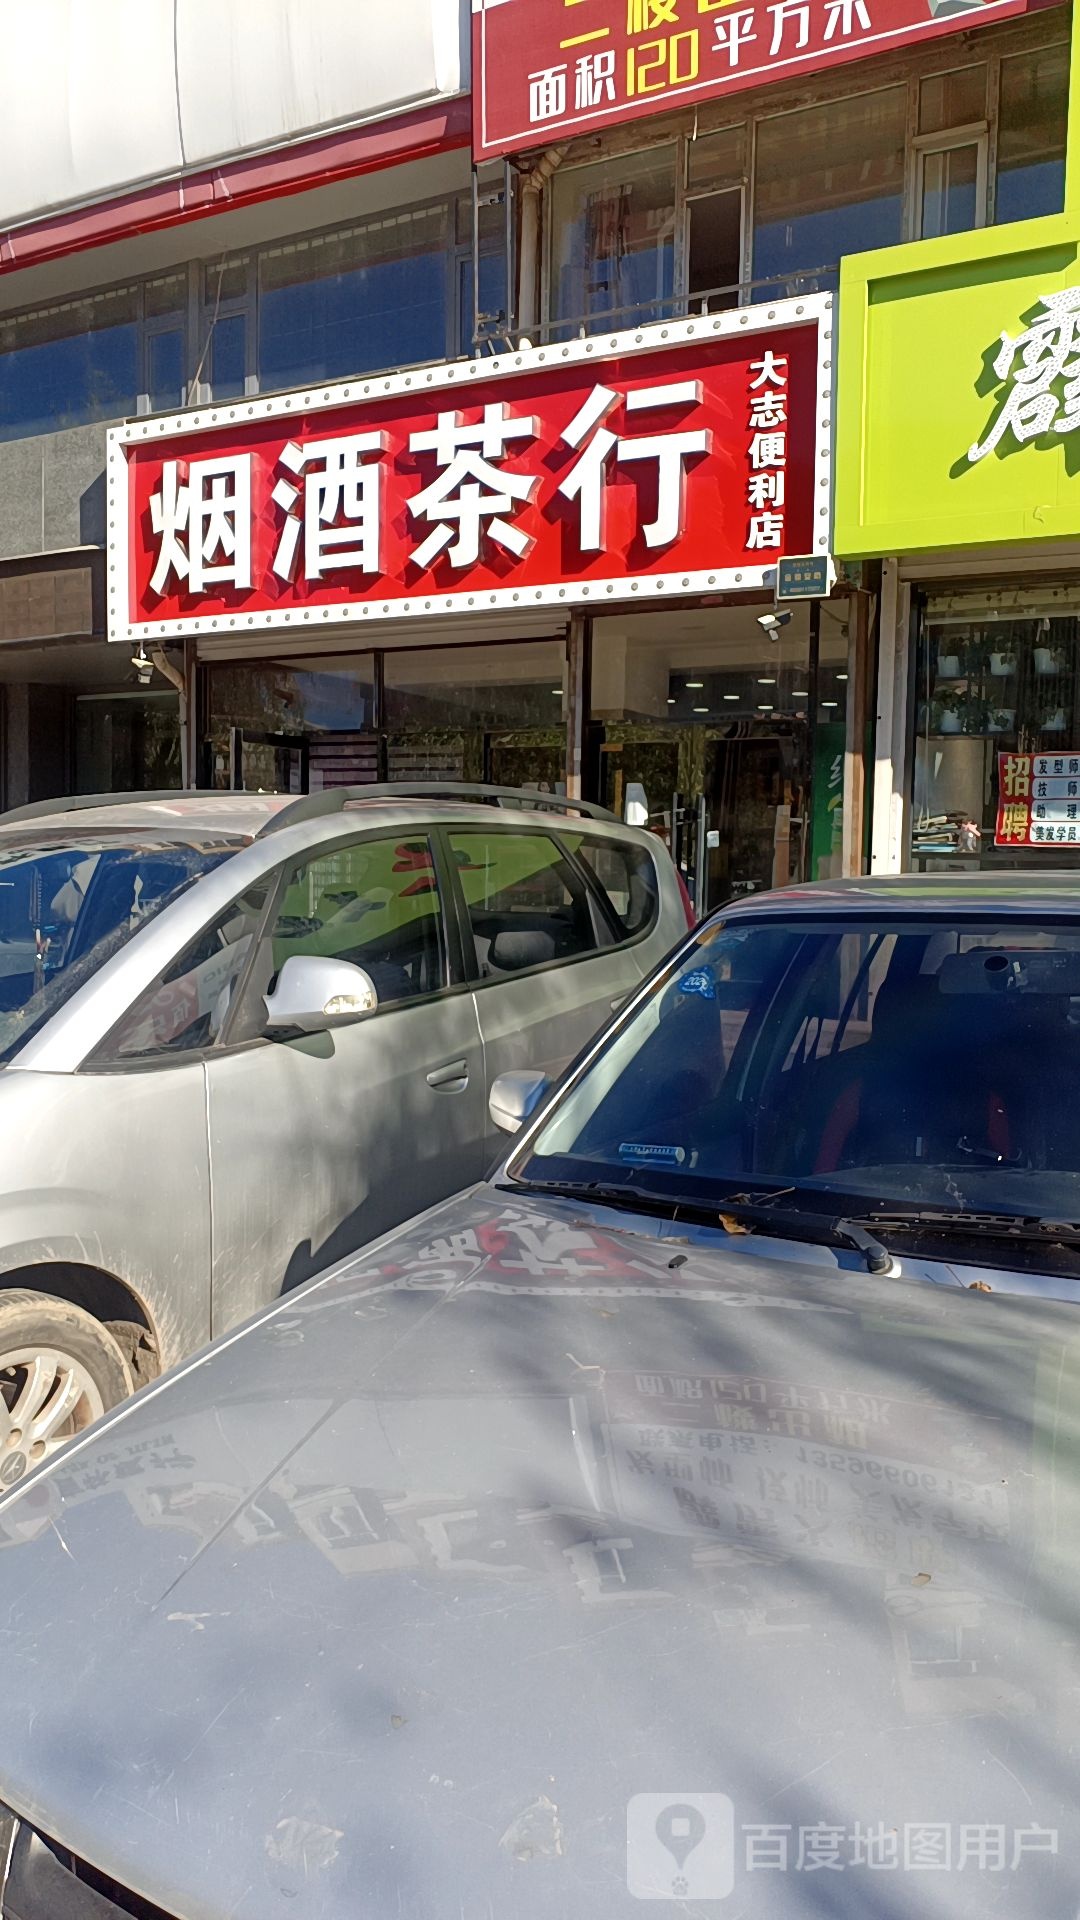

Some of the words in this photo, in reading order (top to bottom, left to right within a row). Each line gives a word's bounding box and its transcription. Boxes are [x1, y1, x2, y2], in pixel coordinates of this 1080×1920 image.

[745, 350, 788, 549] 大志便利店
[148, 379, 714, 596] 烟酒茶行
[1038, 758, 1079, 775] 发型师
[1037, 780, 1078, 797] 技师
[1001, 755, 1031, 842] 招聘
[1036, 803, 1078, 820] 助理
[1034, 825, 1077, 842] 美发学员
